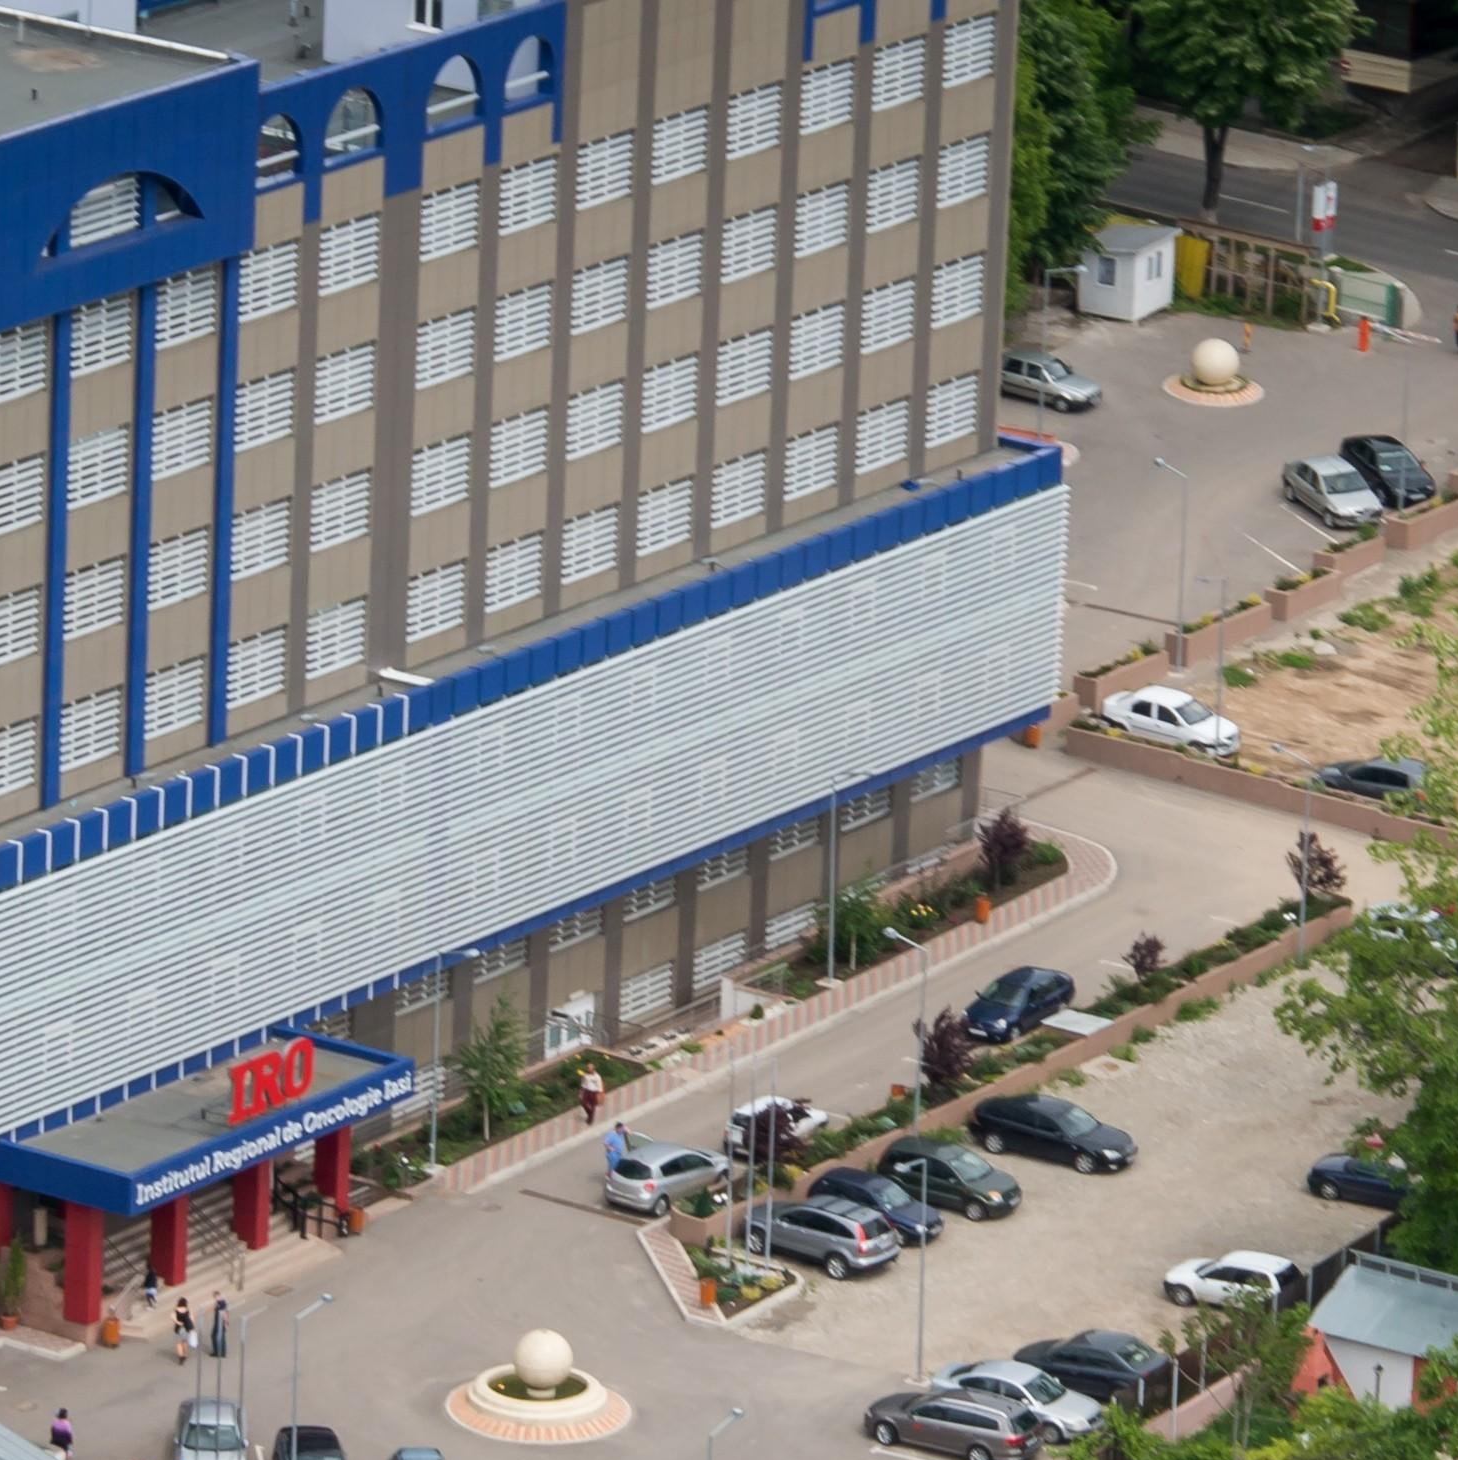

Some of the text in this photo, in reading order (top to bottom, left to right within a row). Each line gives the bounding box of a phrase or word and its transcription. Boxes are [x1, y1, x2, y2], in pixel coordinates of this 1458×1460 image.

[227, 1036, 314, 1126] IRO
[135, 1155, 212, 1206] Institutul
[212, 1125, 283, 1174] Regional
[282, 1120, 303, 1143] de
[303, 1086, 383, 1134] Oncologie
